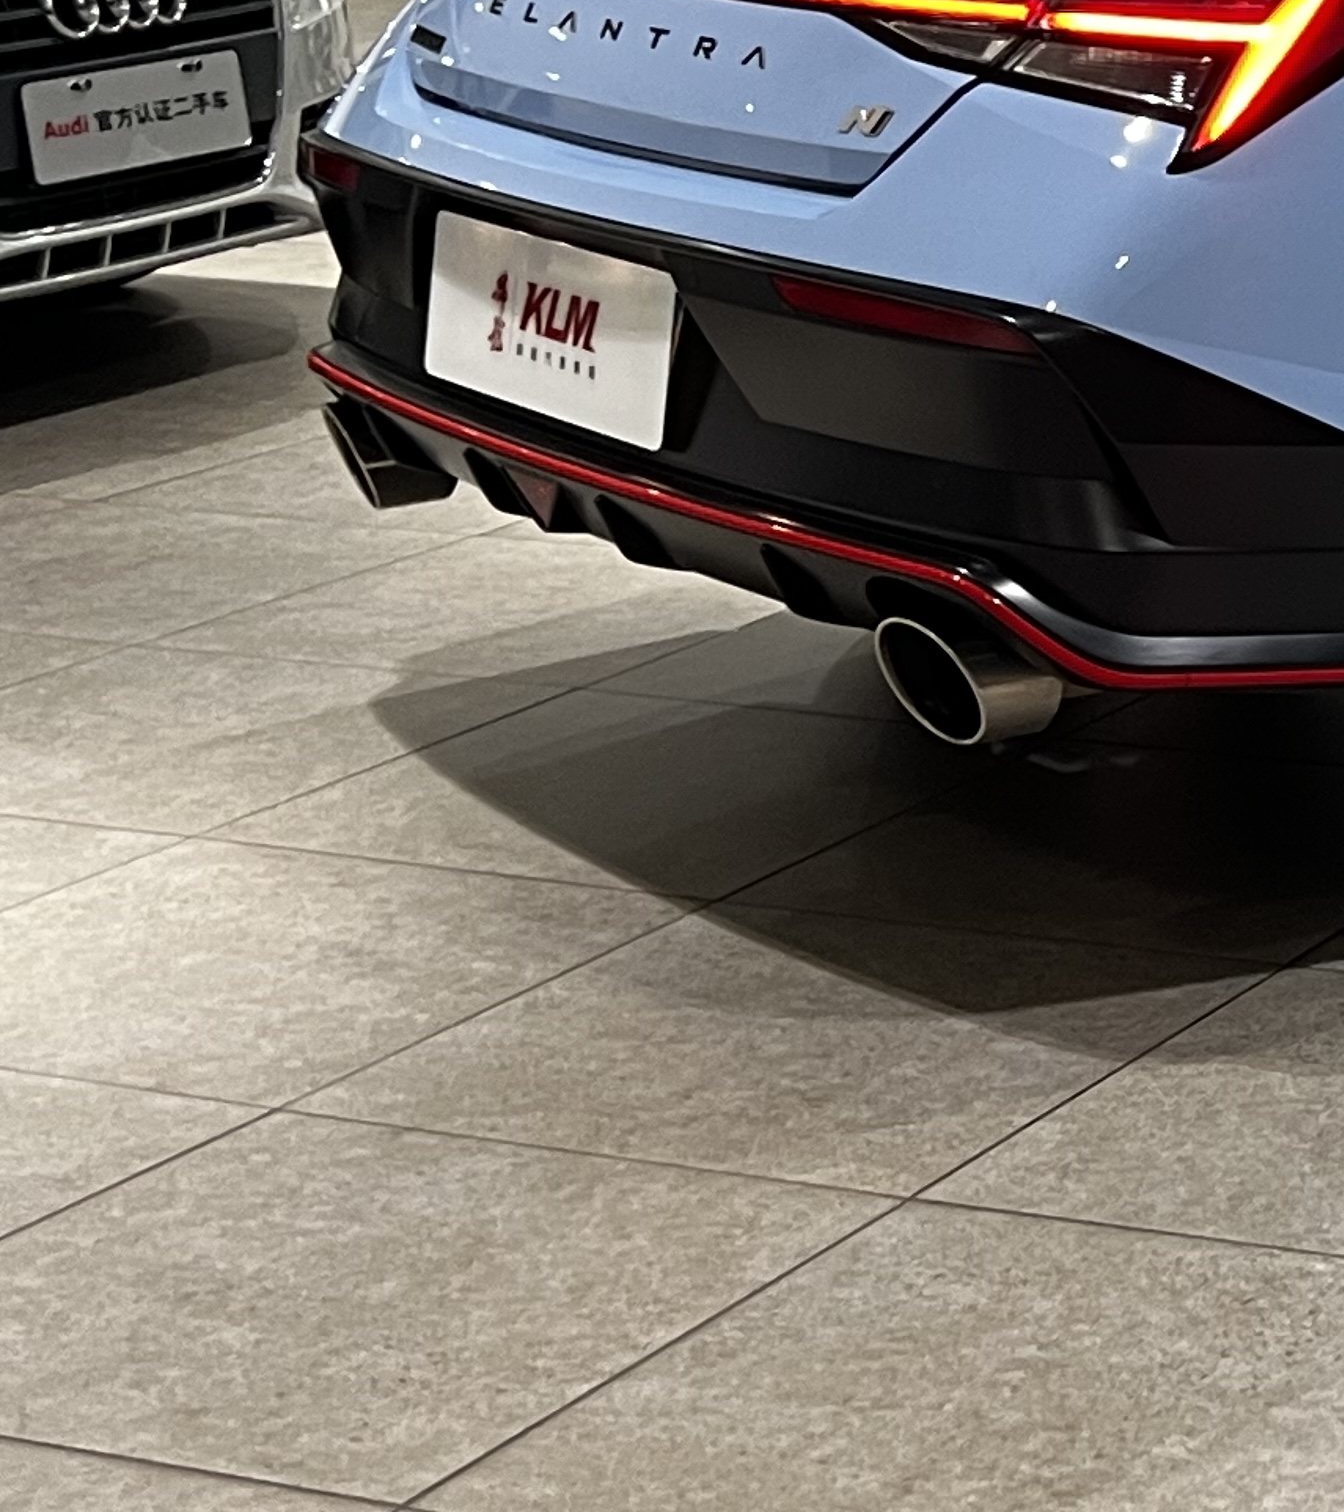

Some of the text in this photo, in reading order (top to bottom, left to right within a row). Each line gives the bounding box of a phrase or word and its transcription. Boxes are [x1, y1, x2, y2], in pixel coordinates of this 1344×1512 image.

[44, 91, 229, 140] Audi 官方认证二手车
[519, 281, 600, 353] KLM
